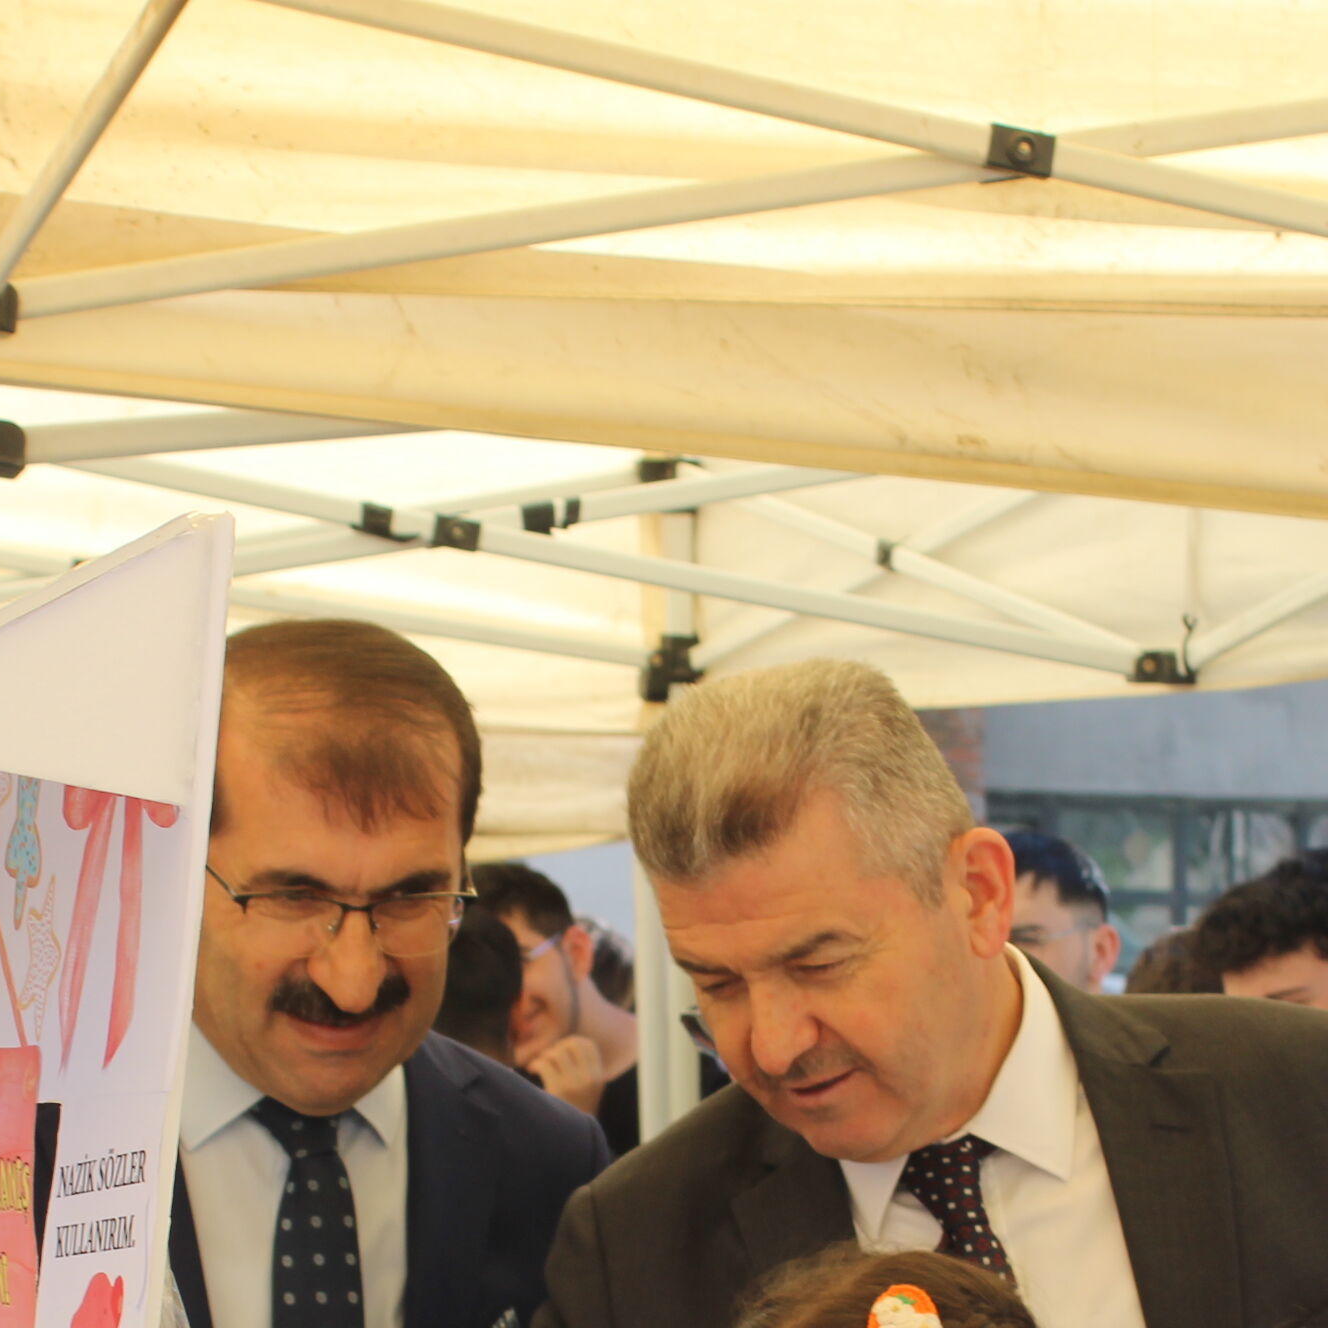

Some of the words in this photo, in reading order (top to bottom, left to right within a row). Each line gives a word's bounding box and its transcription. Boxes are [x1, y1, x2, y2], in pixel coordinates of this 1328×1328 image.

[56, 1154, 98, 1199] NAZİK
[99, 1148, 147, 1192] SÖZLER
[55, 1214, 136, 1258] KULLANIRIM.
